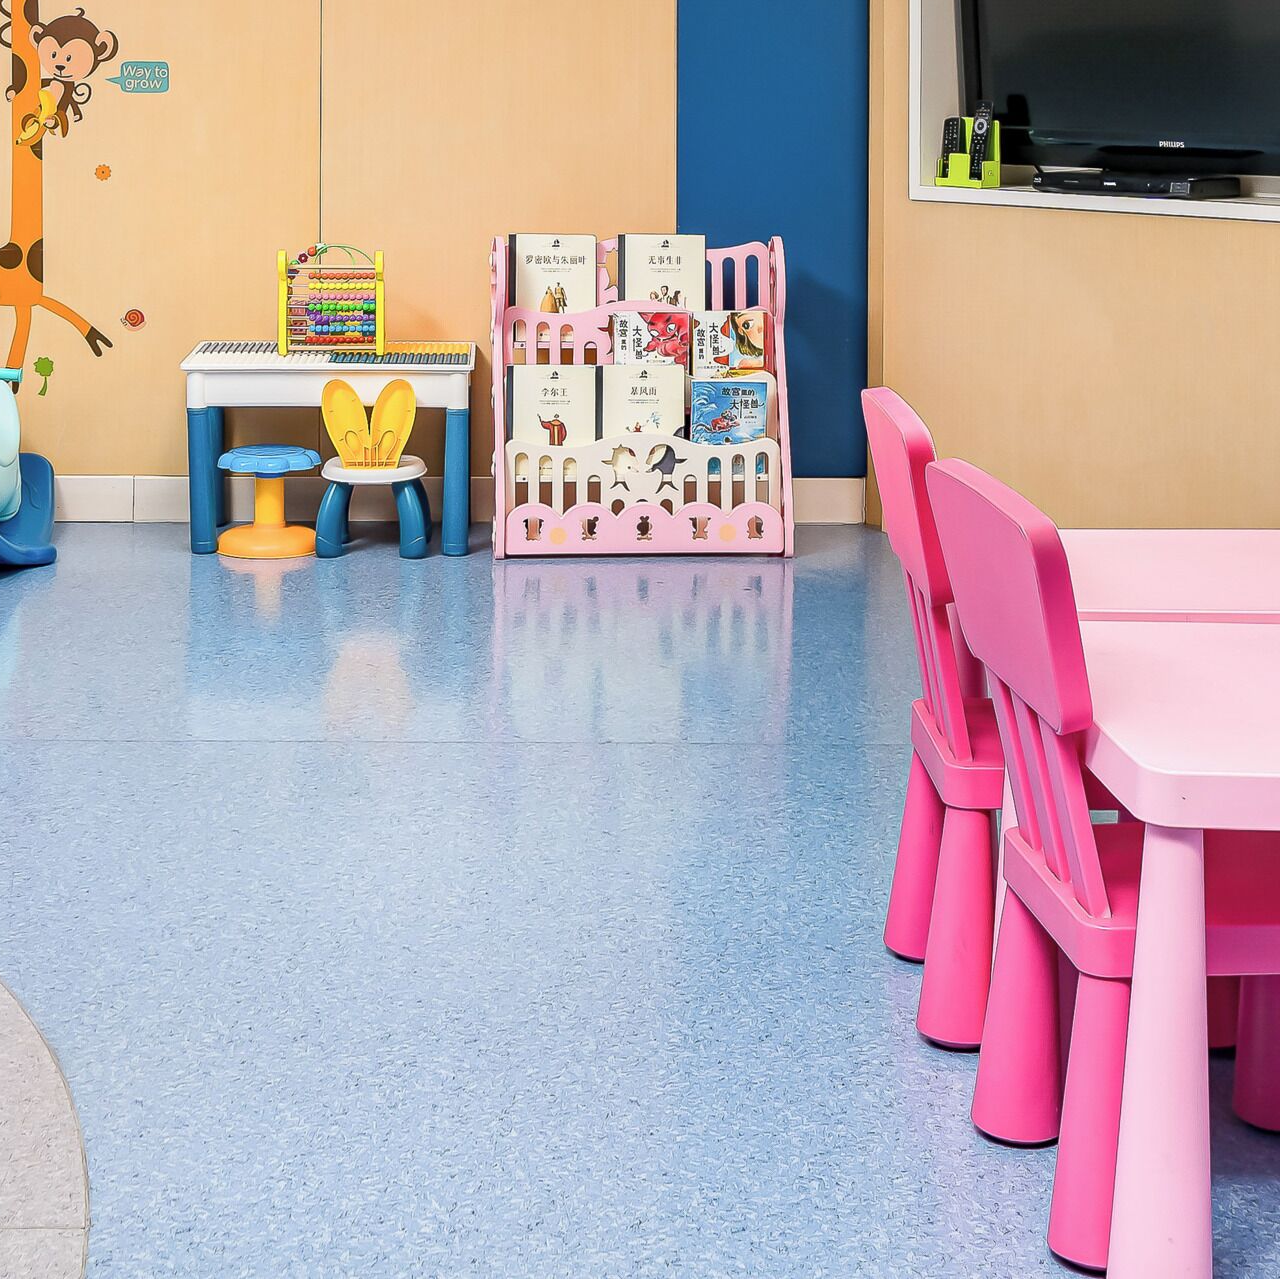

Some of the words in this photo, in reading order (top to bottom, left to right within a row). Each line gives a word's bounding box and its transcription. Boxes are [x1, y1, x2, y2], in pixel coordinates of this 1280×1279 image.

[123, 65, 151, 80] Way
[155, 66, 168, 78] to
[125, 79, 162, 91] grow
[1159, 140, 1185, 148] PHILIPS
[525, 254, 586, 265] 罗密欧与朱丽叶
[632, 325, 643, 360] 大怪兽
[709, 322, 720, 356] 大怪兽
[730, 398, 763, 415] 大怪兽
